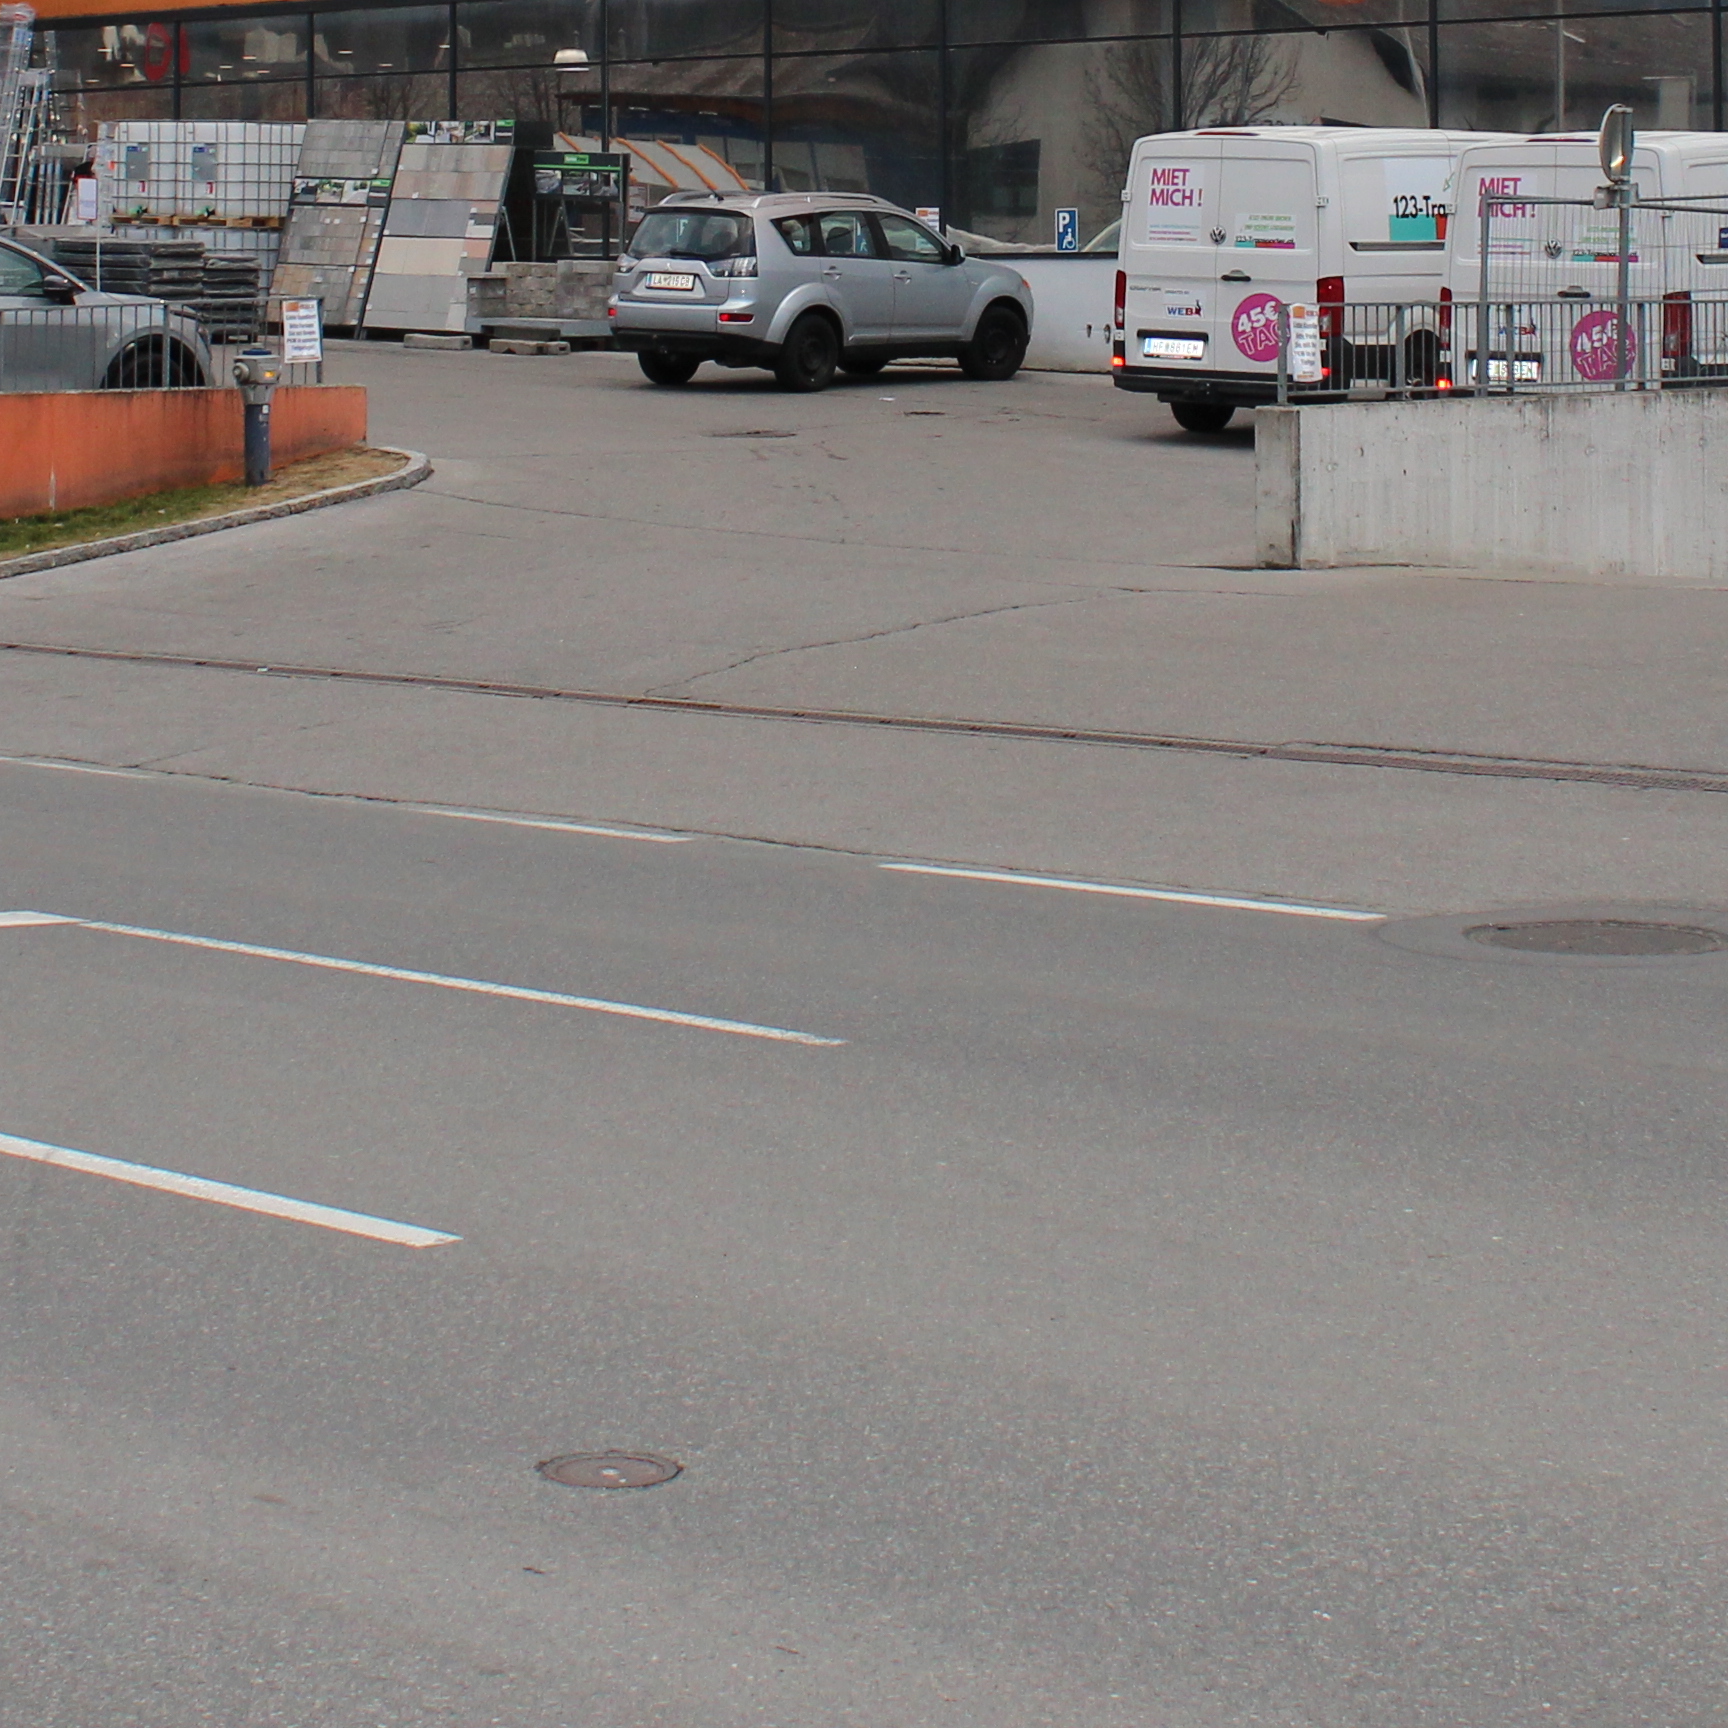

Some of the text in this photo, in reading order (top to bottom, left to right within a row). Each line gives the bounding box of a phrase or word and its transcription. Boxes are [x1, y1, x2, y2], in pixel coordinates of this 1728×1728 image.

[1151, 168, 1190, 186] MIET
[1478, 177, 1522, 196] MIET
[1059, 213, 1070, 233] P
